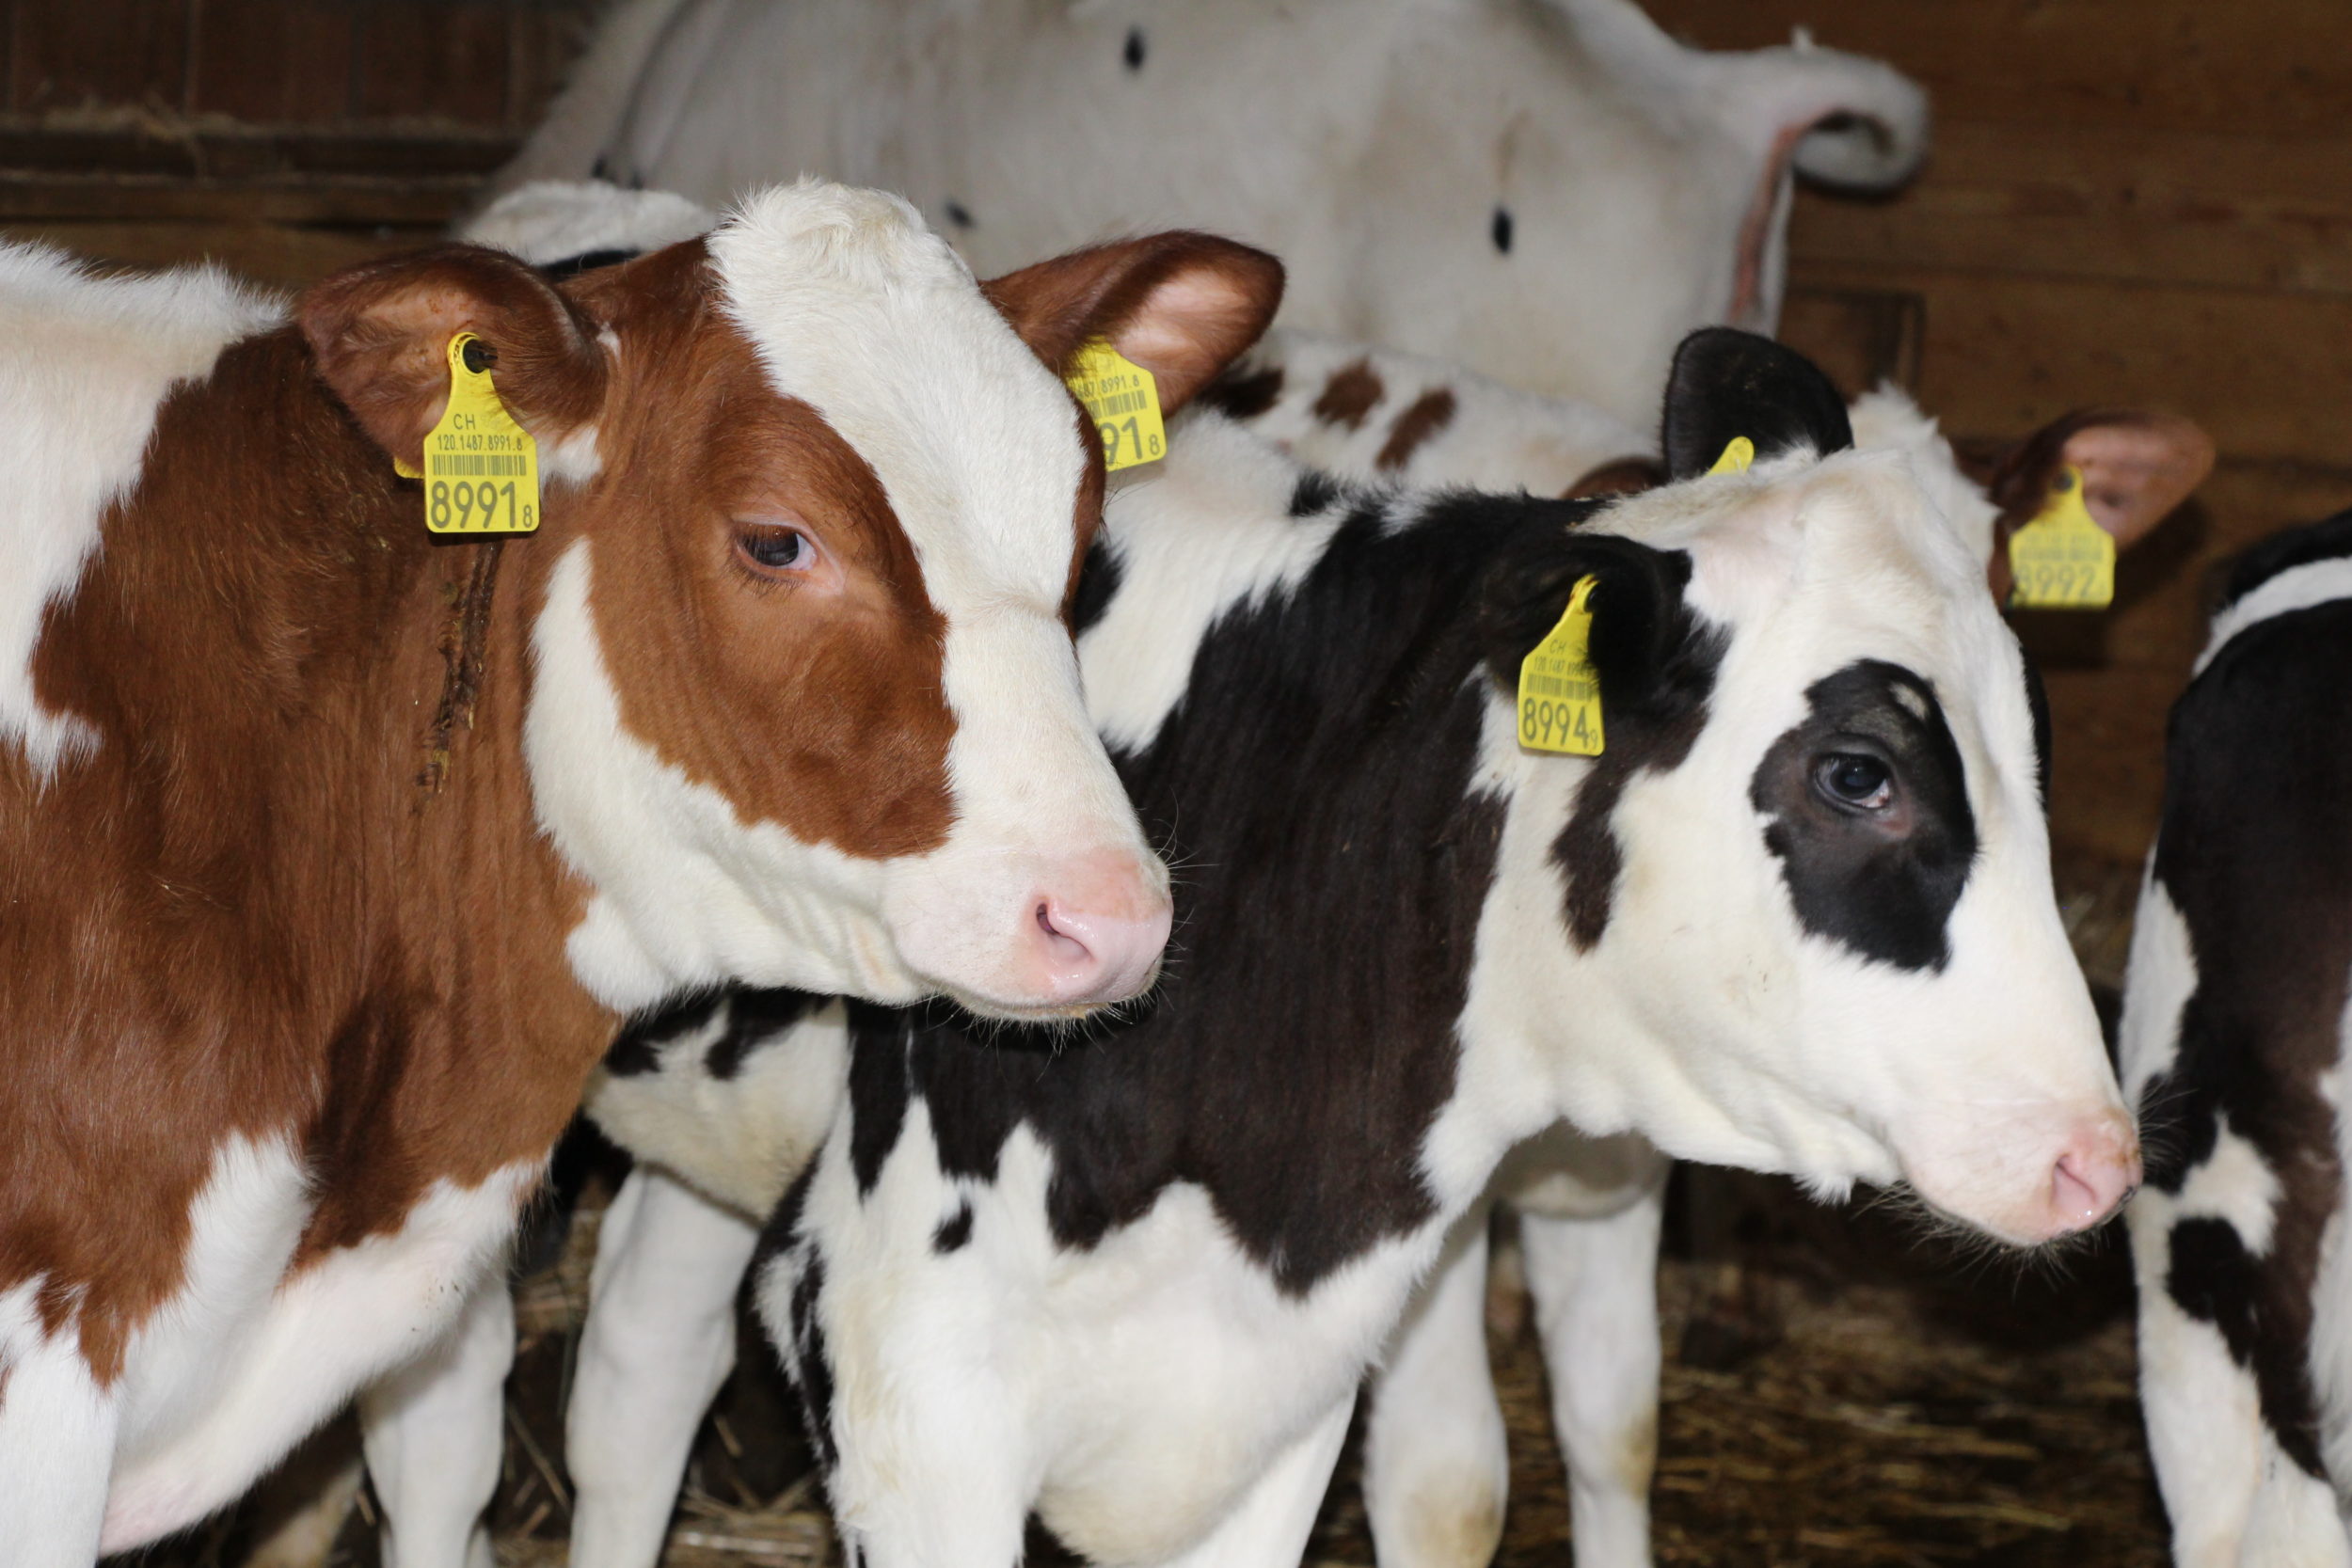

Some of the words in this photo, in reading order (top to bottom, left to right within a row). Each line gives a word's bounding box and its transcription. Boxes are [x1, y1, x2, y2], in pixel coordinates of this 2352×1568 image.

[453, 413, 476, 430] CH
[437, 435, 523, 451] 120.1487.8991.8
[1149, 434, 1160, 455] 8
[431, 481, 516, 529] 8991
[523, 504, 532, 528] 8
[1549, 639, 1566, 656] CH
[1522, 698, 1590, 749] 8994
